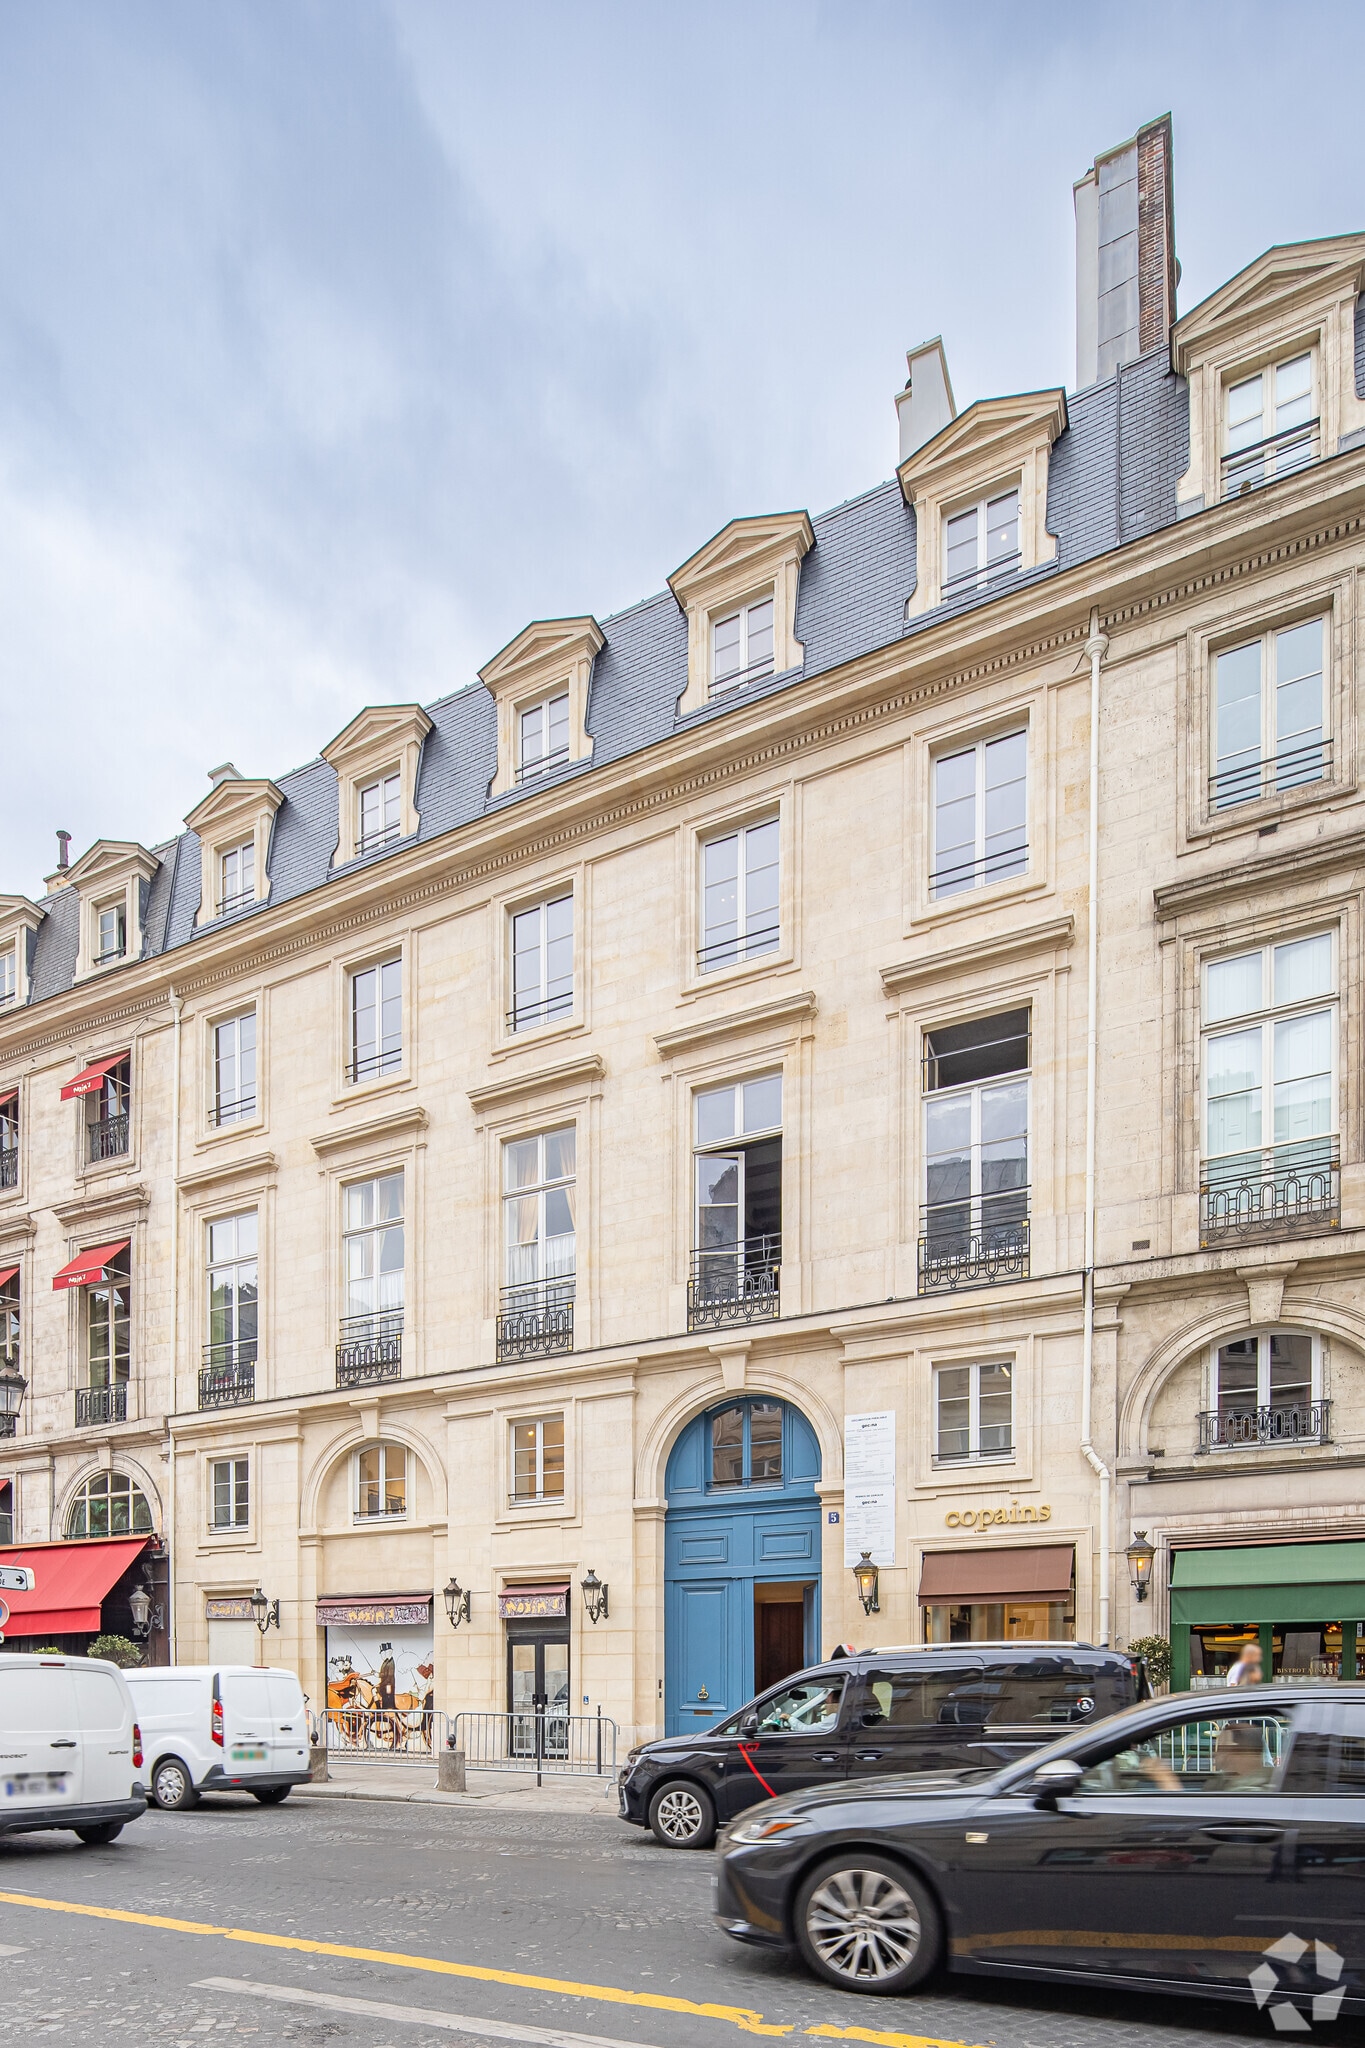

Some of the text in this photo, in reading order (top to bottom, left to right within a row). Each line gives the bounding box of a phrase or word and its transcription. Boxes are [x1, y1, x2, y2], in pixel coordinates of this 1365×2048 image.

[830, 1513, 837, 1523] 5
[945, 1499, 1052, 1533] copains
[745, 1741, 760, 1752] G7
